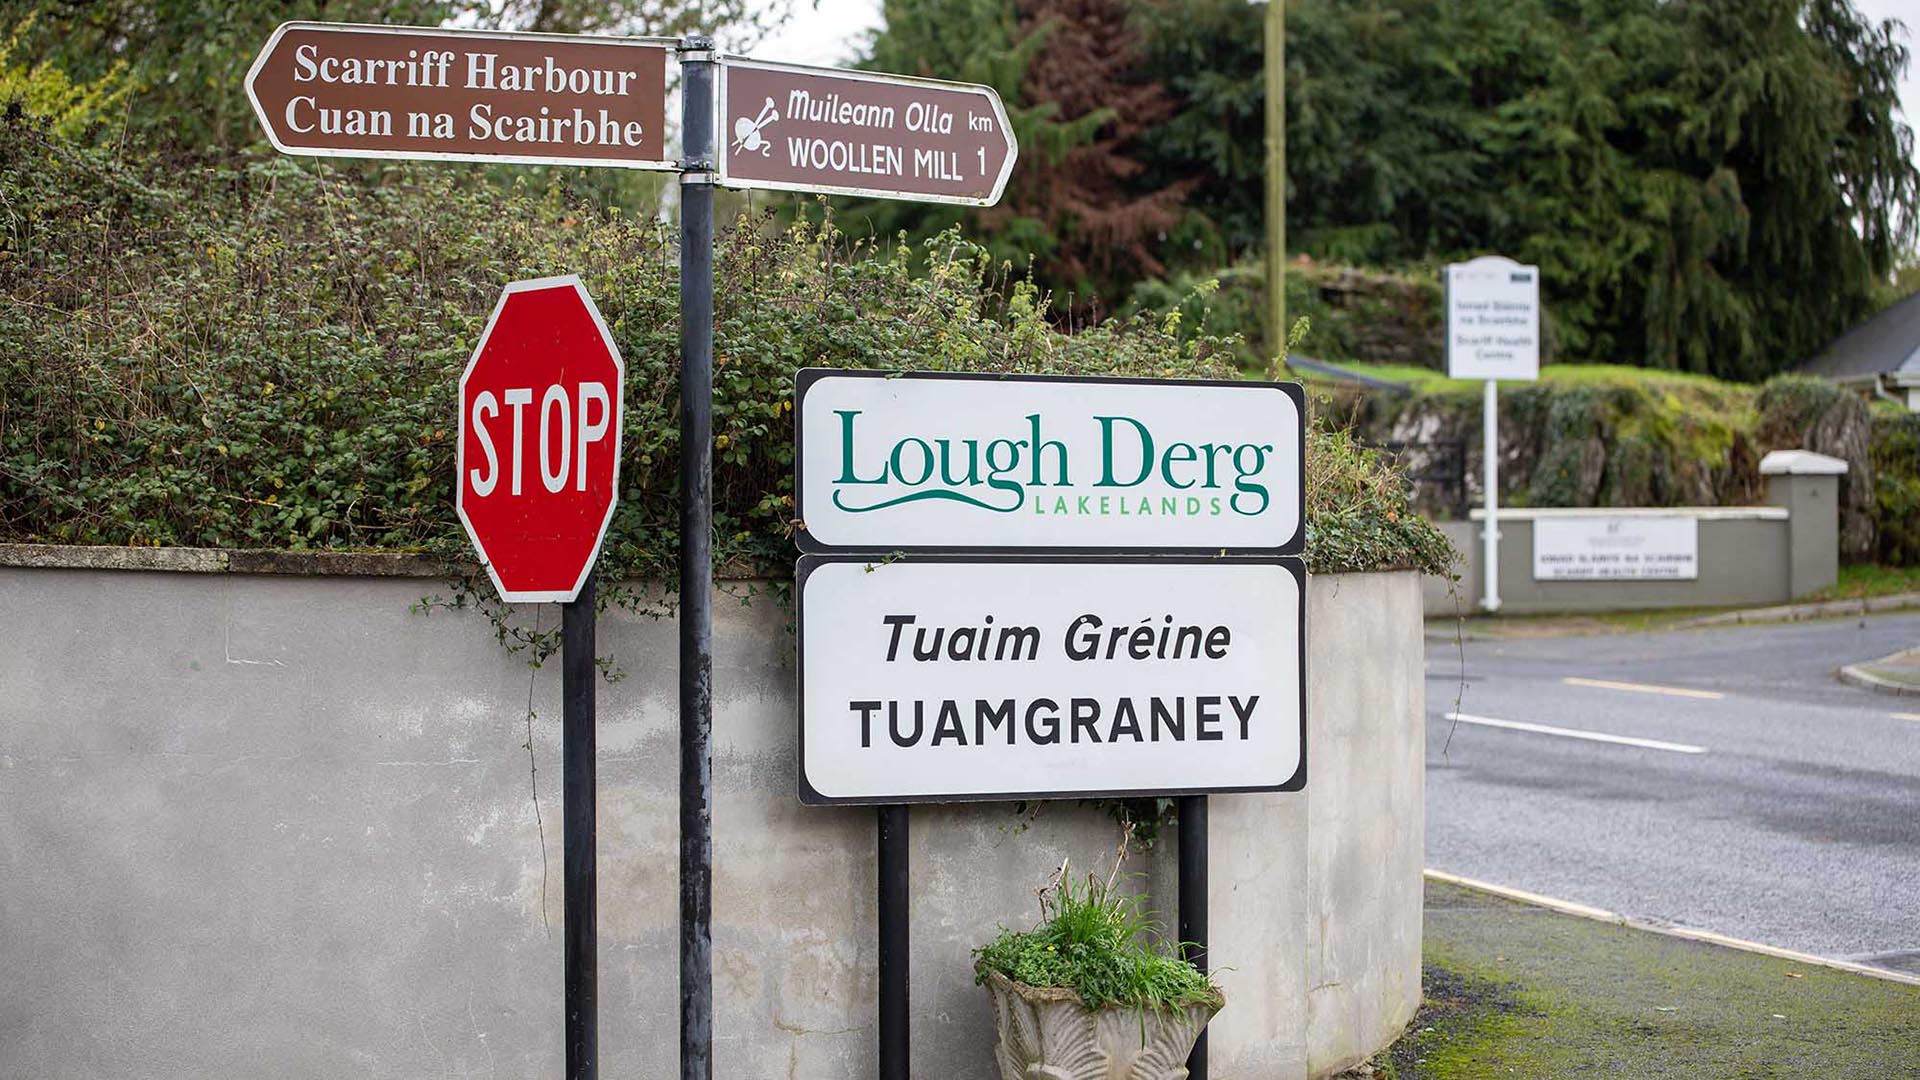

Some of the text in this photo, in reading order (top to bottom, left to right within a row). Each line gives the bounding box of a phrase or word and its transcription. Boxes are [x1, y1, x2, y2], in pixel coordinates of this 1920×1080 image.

[293, 44, 637, 97] Scarriff Harbour
[285, 96, 643, 147] Cuan na Scairbhe
[786, 89, 993, 134] Muileann Olla km
[787, 136, 987, 181] WOOLLEN MILL 1
[470, 382, 610, 497] STOP
[832, 410, 1273, 516] Lough Derg
[1035, 495, 1222, 517] LAKELANDS
[883, 613, 1232, 662] Tuaim Gréine
[849, 695, 1260, 748] TUAMGRANEY
